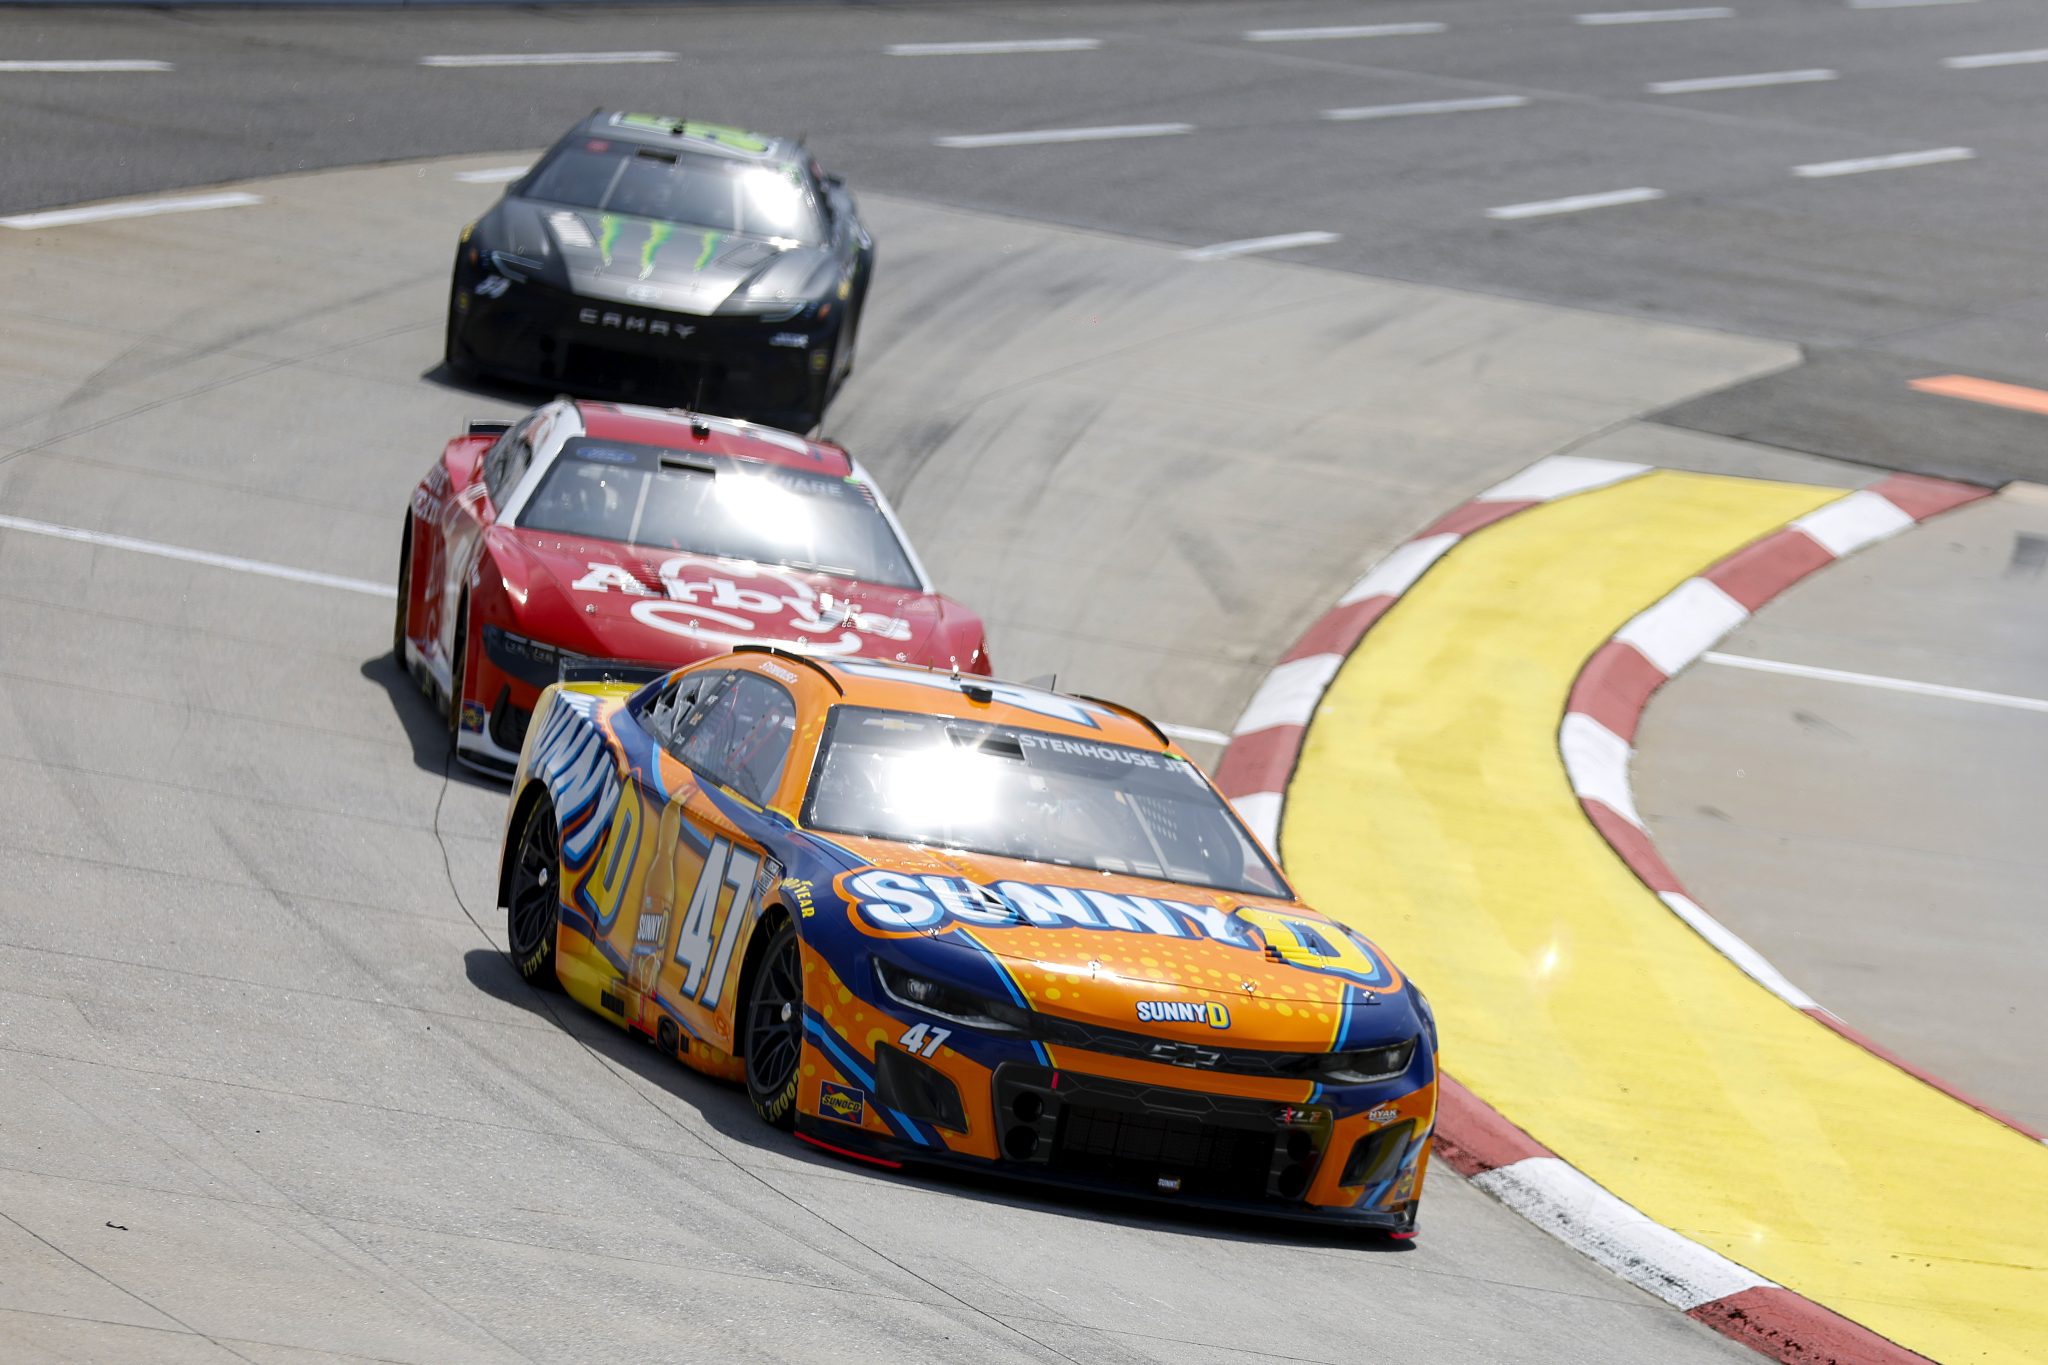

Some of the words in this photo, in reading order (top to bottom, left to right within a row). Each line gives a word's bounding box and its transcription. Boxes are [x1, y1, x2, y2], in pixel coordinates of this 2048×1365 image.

[572, 561, 912, 641] Arby's
[1020, 733, 1160, 769] STENHOUSE
[674, 834, 760, 1011] 47
[899, 1021, 953, 1059] 47
[823, 1094, 862, 1113] SUNOCO
